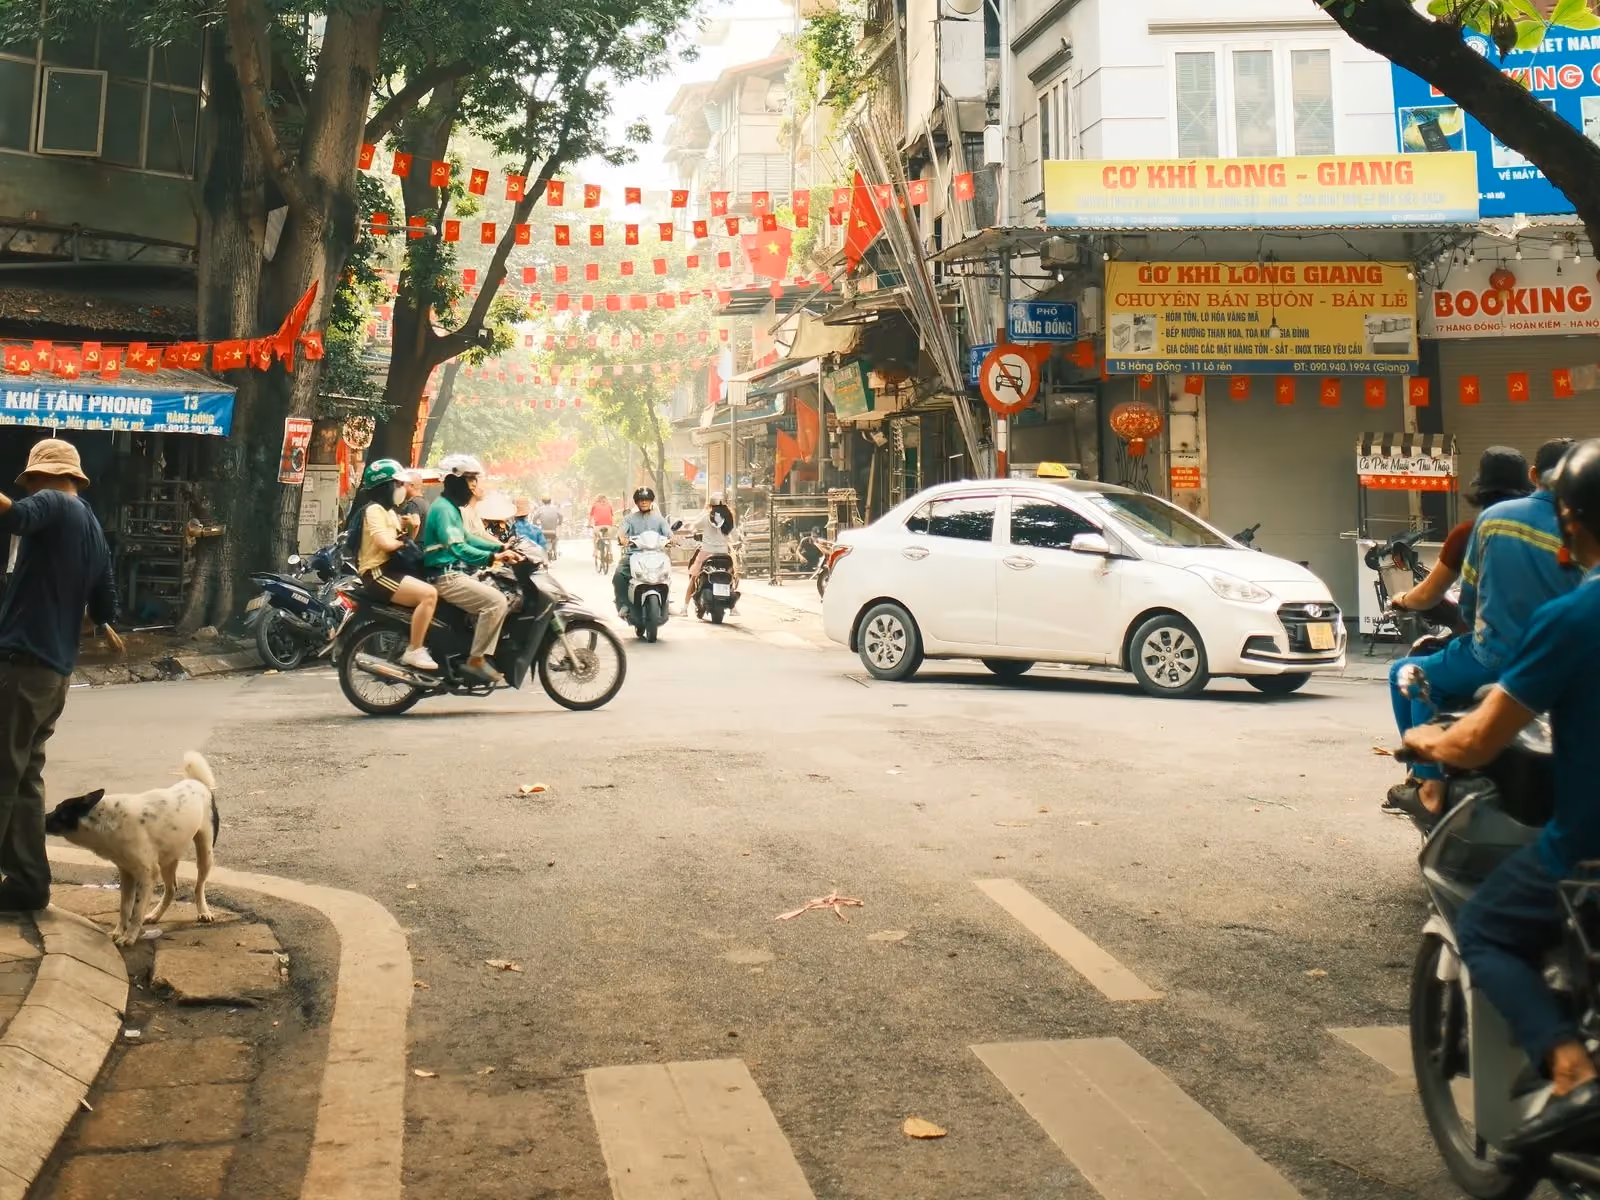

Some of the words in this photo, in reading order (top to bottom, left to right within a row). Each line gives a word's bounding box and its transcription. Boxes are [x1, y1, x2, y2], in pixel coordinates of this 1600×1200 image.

[1102, 165, 1140, 189] CƠ
[1147, 160, 1197, 189] KHÍ
[1205, 163, 1287, 188] LONG
[1317, 161, 1414, 187] GIANG
[1228, 265, 1296, 284] LONG
[1303, 265, 1383, 284] GIANG
[1115, 290, 1200, 308] CHUYÊN
[1207, 289, 1249, 308] BÁN
[1256, 290, 1314, 308] BUÔN
[1332, 289, 1379, 308] BÁN
[1381, 289, 1409, 308] LẺ
[1433, 285, 1593, 318] BOOKING
[1207, 328, 1226, 338] THAN
[1166, 344, 1178, 354] GIA
[1295, 344, 1312, 355] INOX
[1313, 344, 1331, 355] THEO
[1116, 361, 1126, 371] 15
[1191, 362, 1200, 370] 11
[1293, 362, 1309, 372] ĐT:
[1310, 362, 1371, 372] 090.940.1994
[1373, 362, 1410, 374] (Giang)
[5, 388, 41, 410] KHÍ
[45, 390, 83, 412] TÂN
[88, 394, 153, 416] PHONG
[183, 394, 199, 411] 13
